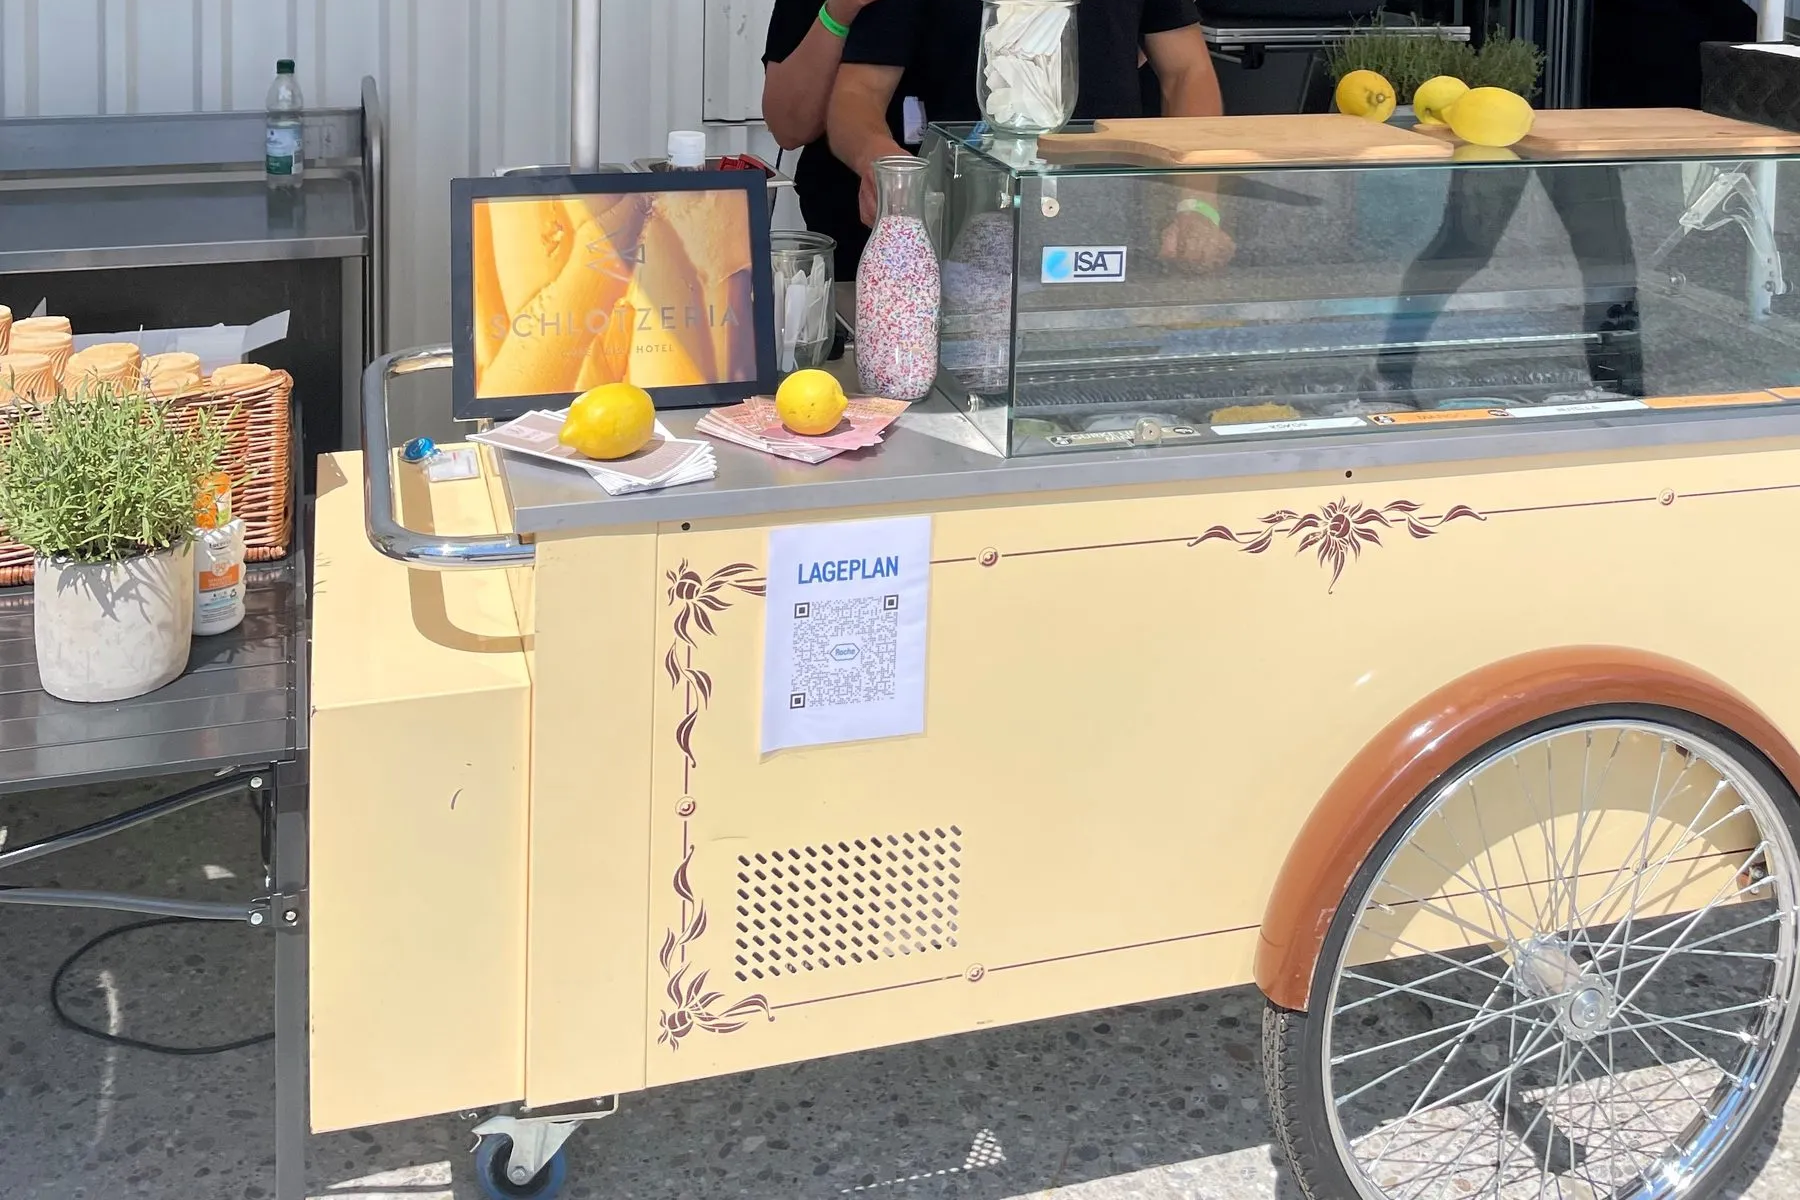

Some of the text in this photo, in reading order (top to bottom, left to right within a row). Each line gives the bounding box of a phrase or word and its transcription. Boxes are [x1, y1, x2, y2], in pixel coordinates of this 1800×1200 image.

[1074, 251, 1108, 272] ISA
[636, 343, 674, 354] HOTEL
[798, 555, 899, 585] LAGEPLAN
[835, 647, 856, 657] Roche
